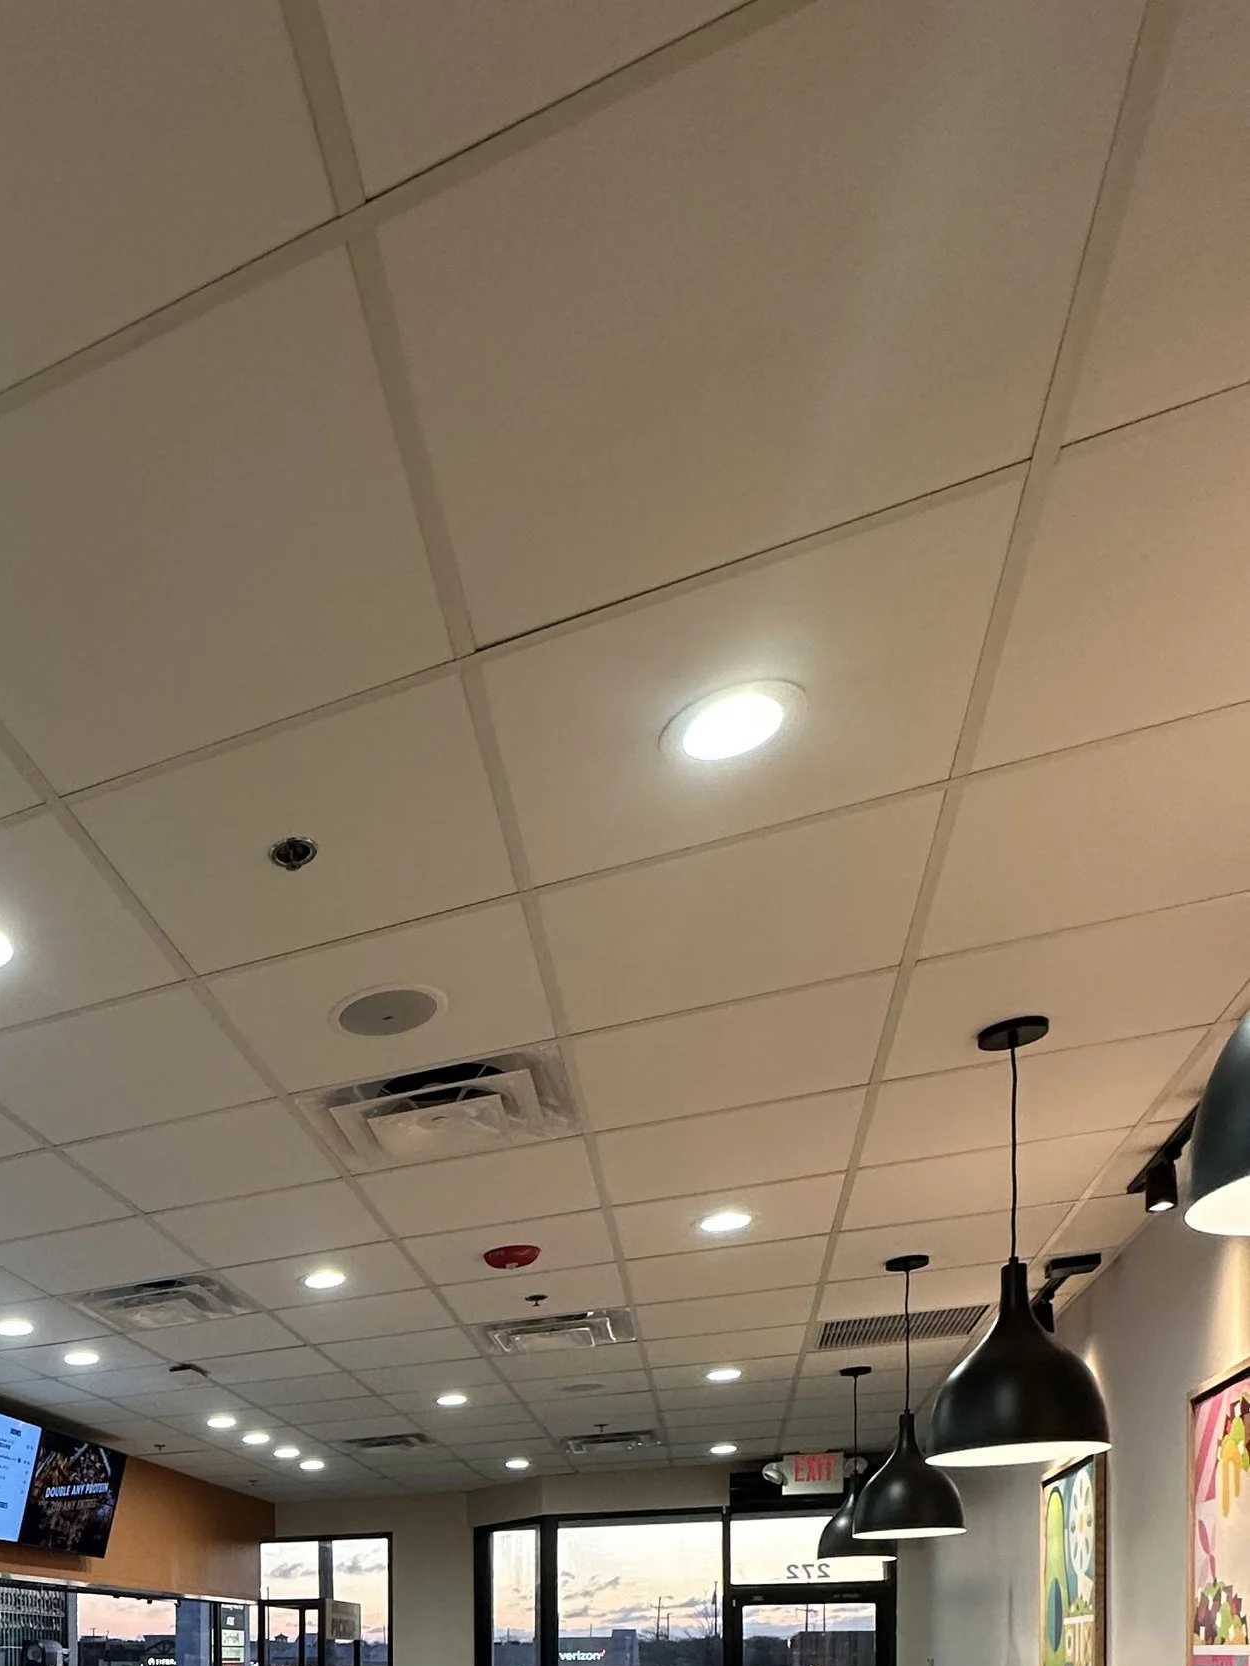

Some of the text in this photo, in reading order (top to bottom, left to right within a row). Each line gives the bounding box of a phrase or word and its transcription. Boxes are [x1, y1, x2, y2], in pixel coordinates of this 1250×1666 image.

[793, 1455, 836, 1483] EXIT
[45, 1485, 71, 1498] DOUBLE
[71, 1484, 85, 1495] ANY
[558, 1650, 601, 1660] verizon
